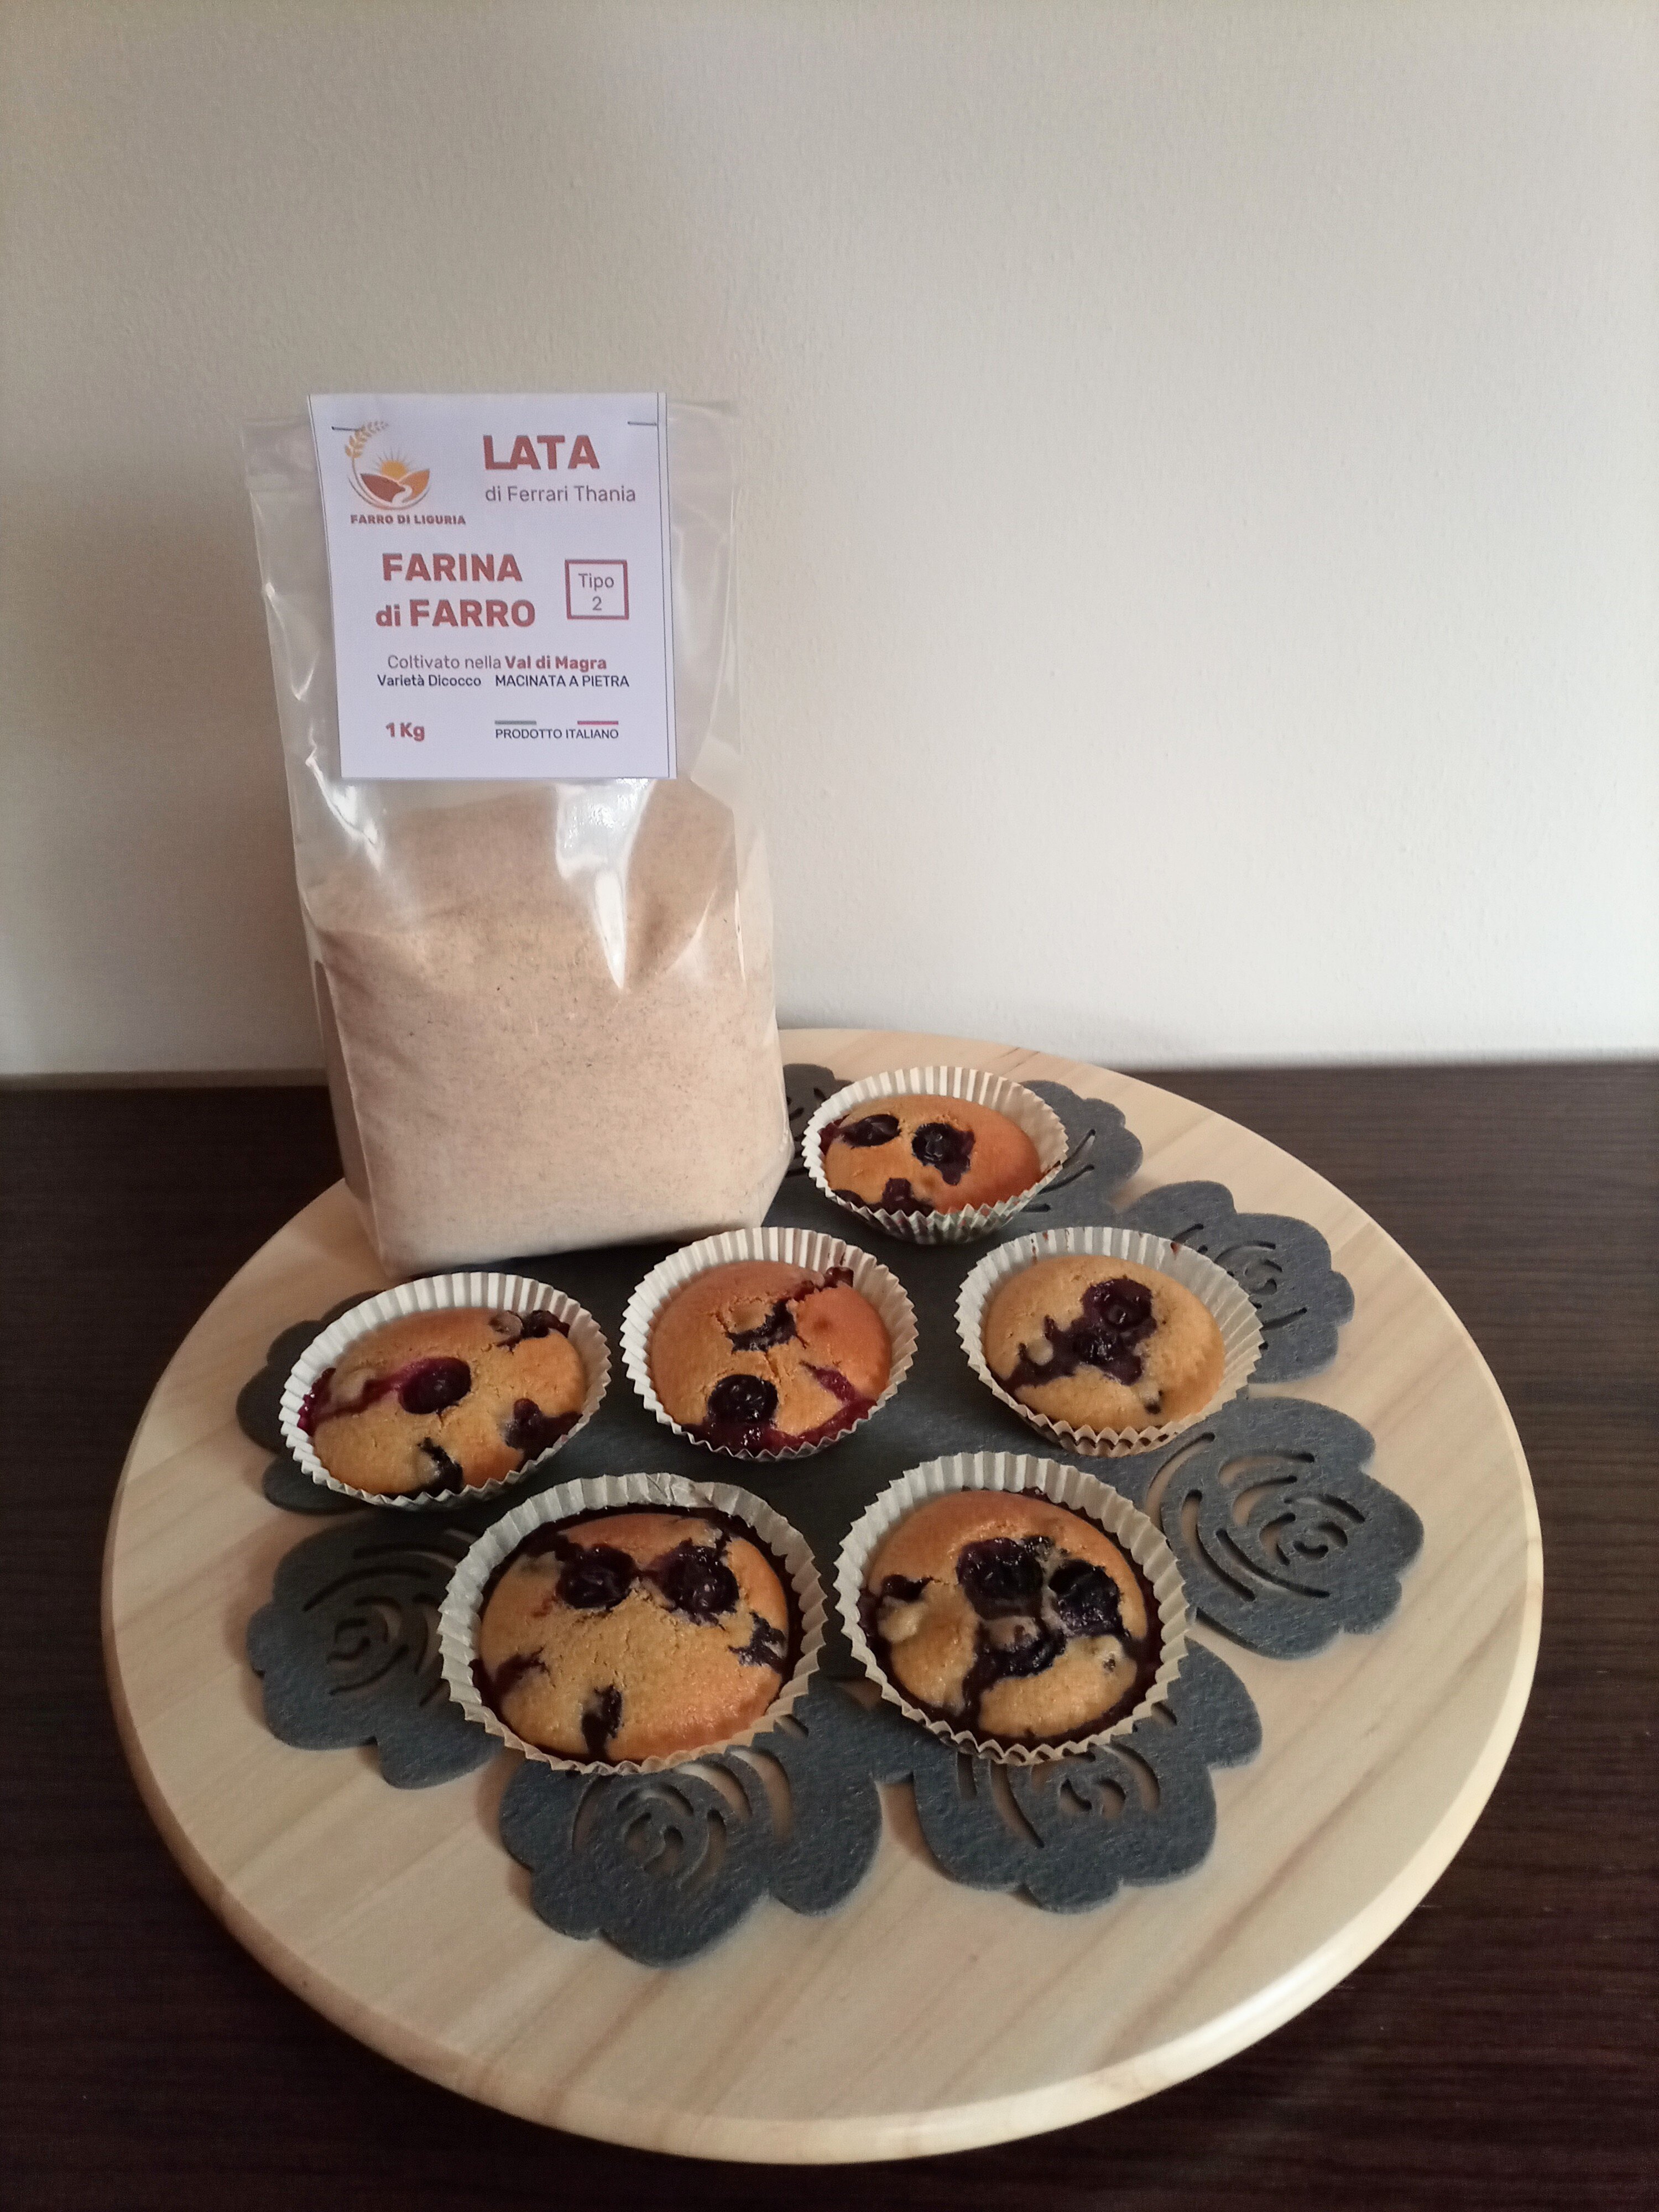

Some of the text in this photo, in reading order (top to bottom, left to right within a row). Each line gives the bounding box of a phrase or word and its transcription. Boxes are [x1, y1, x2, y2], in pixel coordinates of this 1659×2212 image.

[483, 435, 600, 470] LATA
[485, 485, 636, 502] di Ferrari Thania
[350, 514, 466, 525] FARRO DI LIGURIA
[382, 553, 523, 581] FARINA
[578, 573, 614, 591] Tipo
[592, 596, 602, 611] 2
[375, 599, 535, 627] di FARRO
[388, 655, 607, 672] Coltivato nella Val di Magra
[377, 674, 482, 687] Varietà Dicocco
[495, 675, 629, 687] MACINATA A PIETRA
[386, 723, 425, 742] 1 Kg
[495, 729, 619, 739] PRODOTTO ITALIANO
